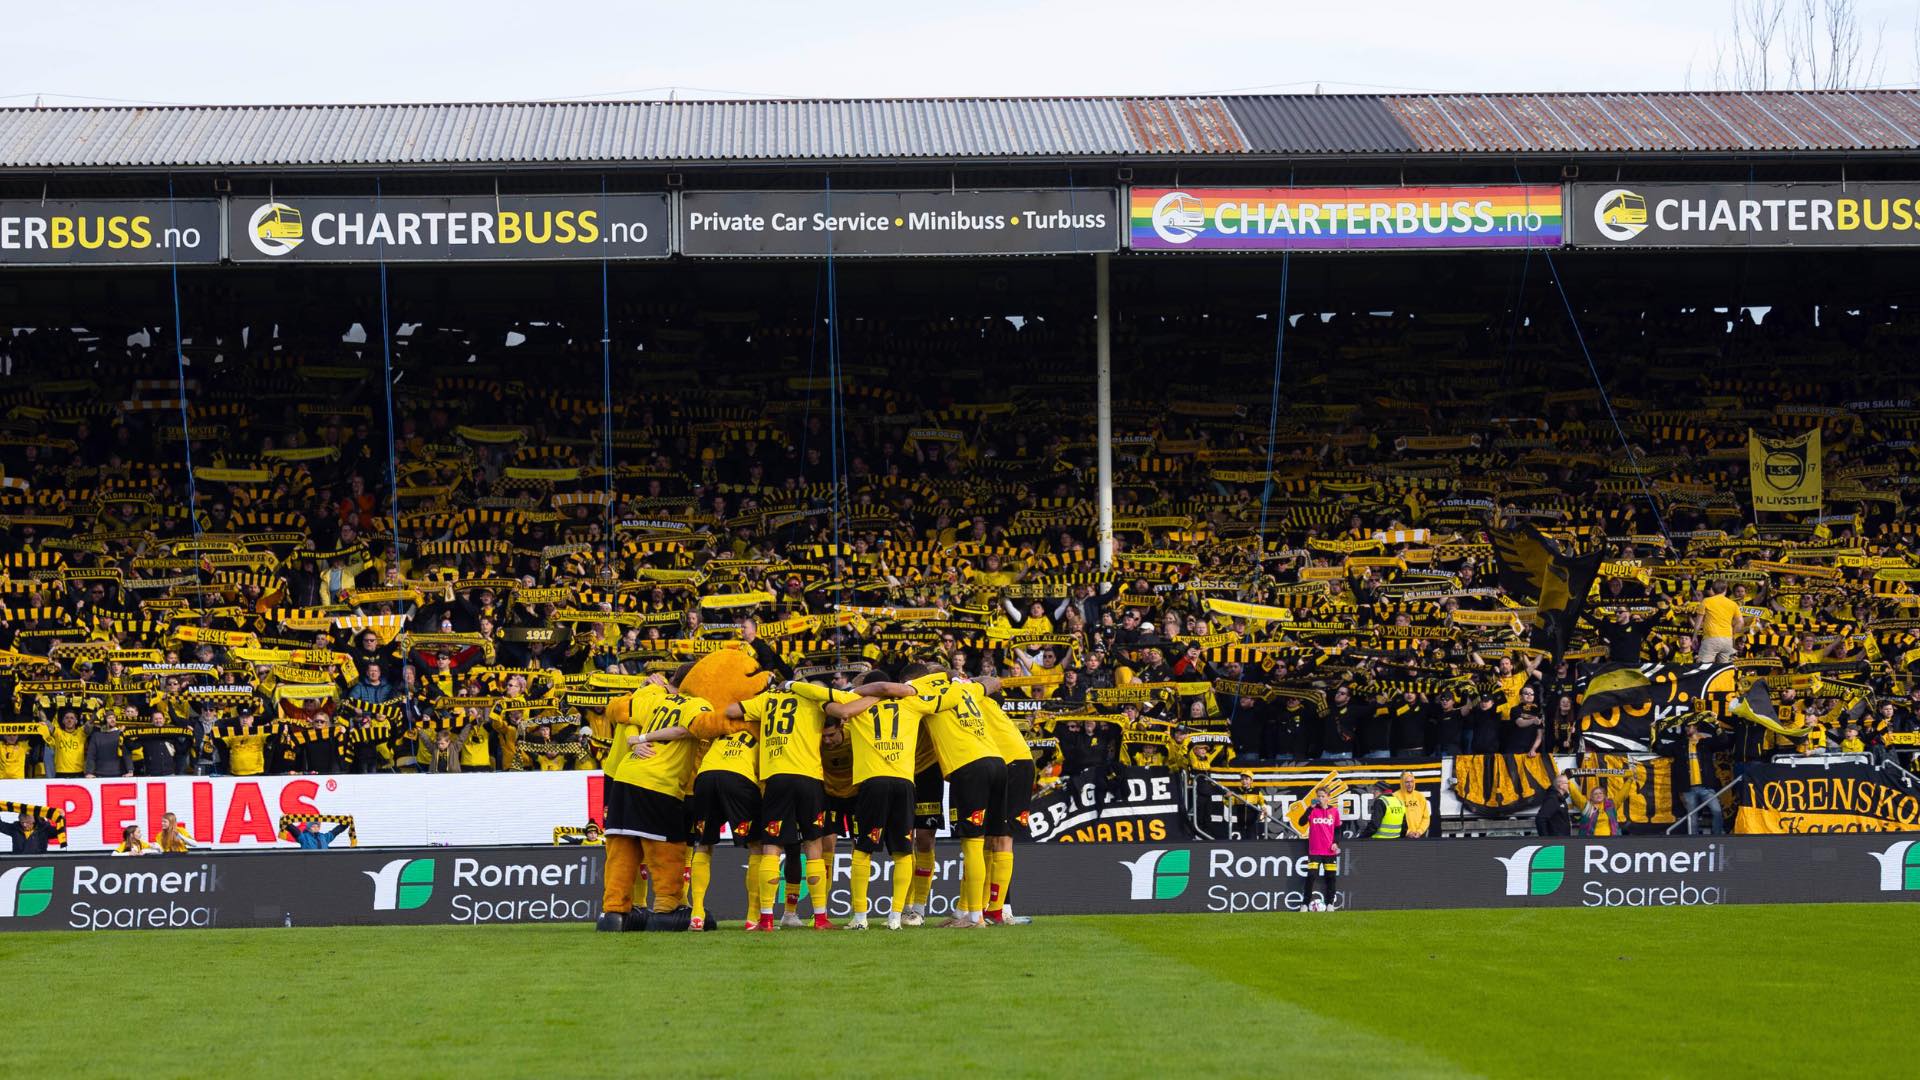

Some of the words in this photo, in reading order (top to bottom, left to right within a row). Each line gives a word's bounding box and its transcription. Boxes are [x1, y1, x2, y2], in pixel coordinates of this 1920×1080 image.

[1214, 200, 1542, 236] CHARTERBUSS.no
[1654, 198, 1920, 231] CHARTERBUS
[690, 211, 764, 232] Private
[771, 211, 807, 231] Car
[812, 210, 889, 231] Service
[908, 209, 1004, 231] Minibuss
[1023, 209, 1106, 230] Turbuss
[311, 210, 648, 245] CHARTERBUSS.no
[1769, 466, 1792, 475] LSK
[622, 520, 649, 528] ALDRI
[651, 520, 686, 529] ALEINE!
[70, 569, 118, 577] LILLESTRØM
[526, 630, 554, 641] 1917
[1387, 626, 1410, 637] PYRO
[1423, 626, 1452, 637] PARTY
[141, 650, 153, 659] SK
[142, 663, 173, 671] ALDRI
[176, 663, 214, 671] ALEINE!
[188, 685, 217, 694] ALDRI
[764, 698, 798, 737] 33
[868, 703, 899, 740] 17
[27, 724, 39, 733] SK
[1313, 817, 1334, 826] coop
